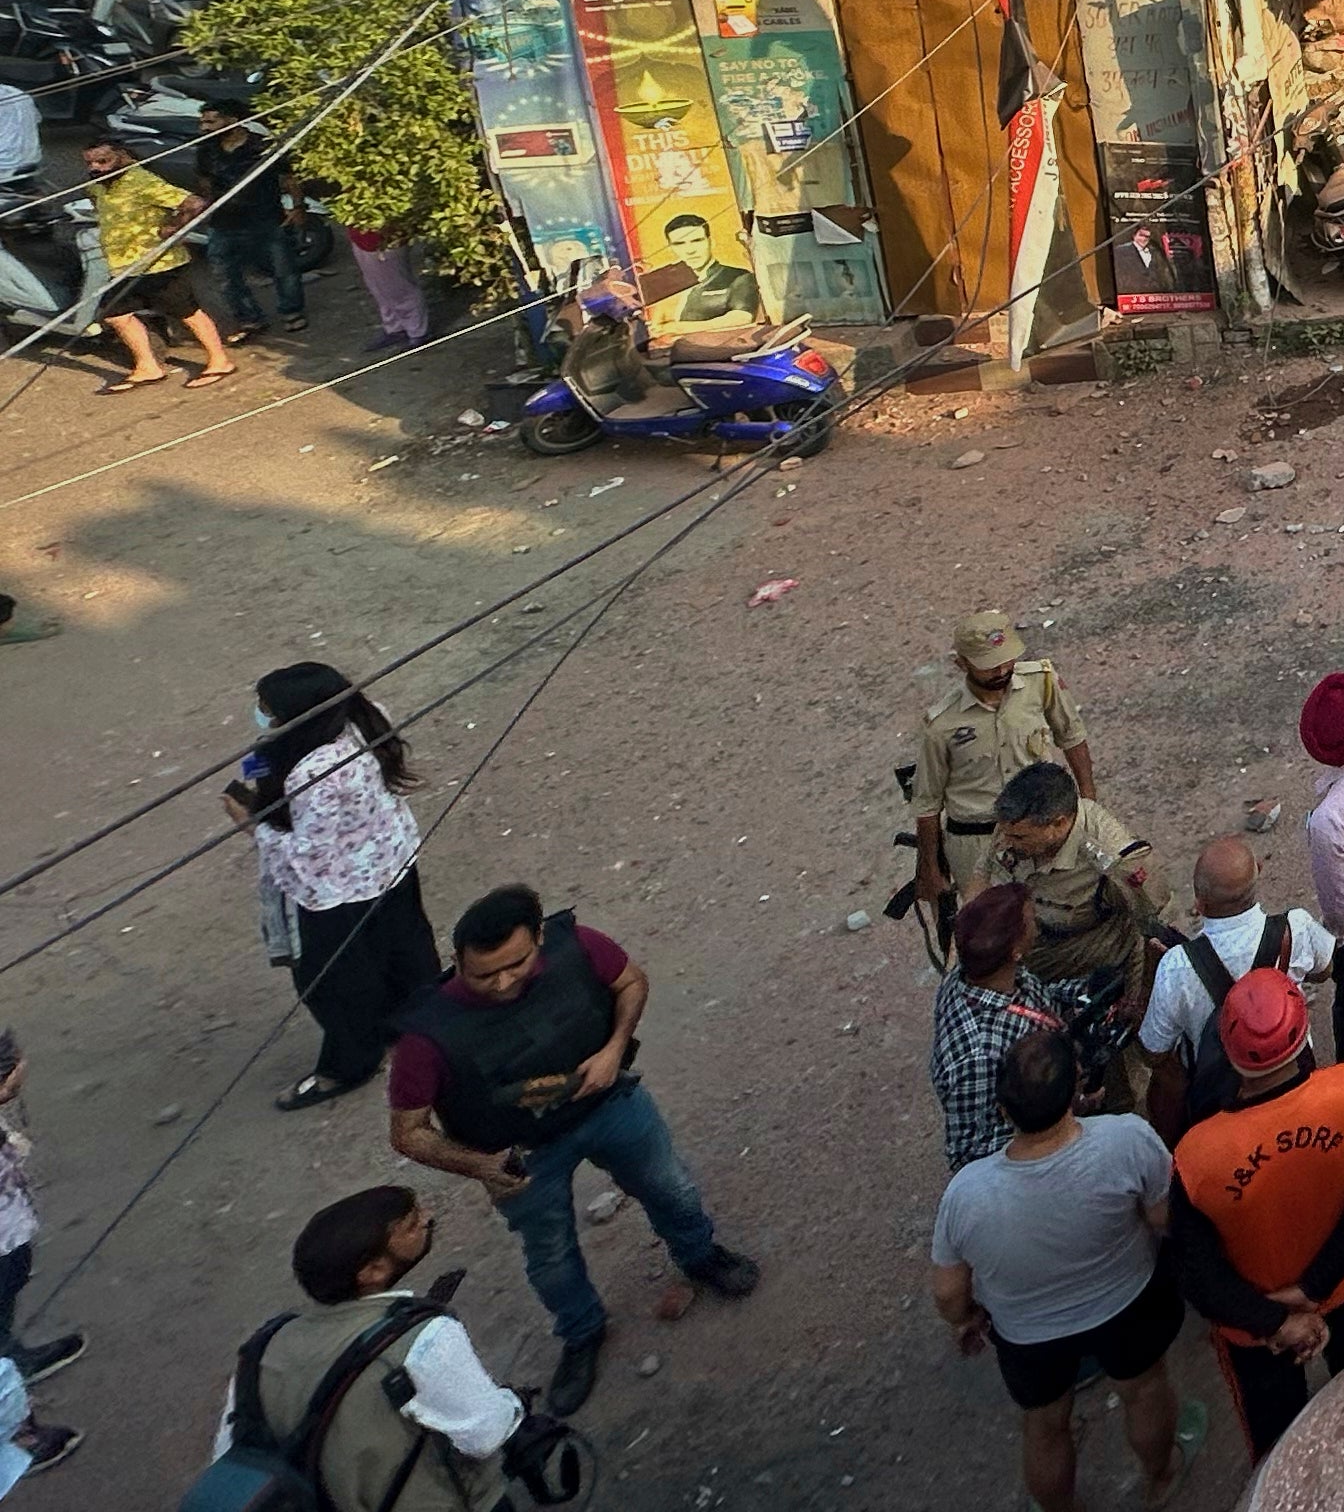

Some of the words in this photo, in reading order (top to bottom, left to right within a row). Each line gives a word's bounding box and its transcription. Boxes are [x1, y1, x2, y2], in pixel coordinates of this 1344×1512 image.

[719, 61, 749, 72] SAY
[751, 59, 775, 69] NO
[632, 130, 689, 152] THIS
[1009, 99, 1038, 193] ACCESSOR
[1225, 1143, 1271, 1201] J&K
[1276, 1125, 1344, 1153] SDRF
